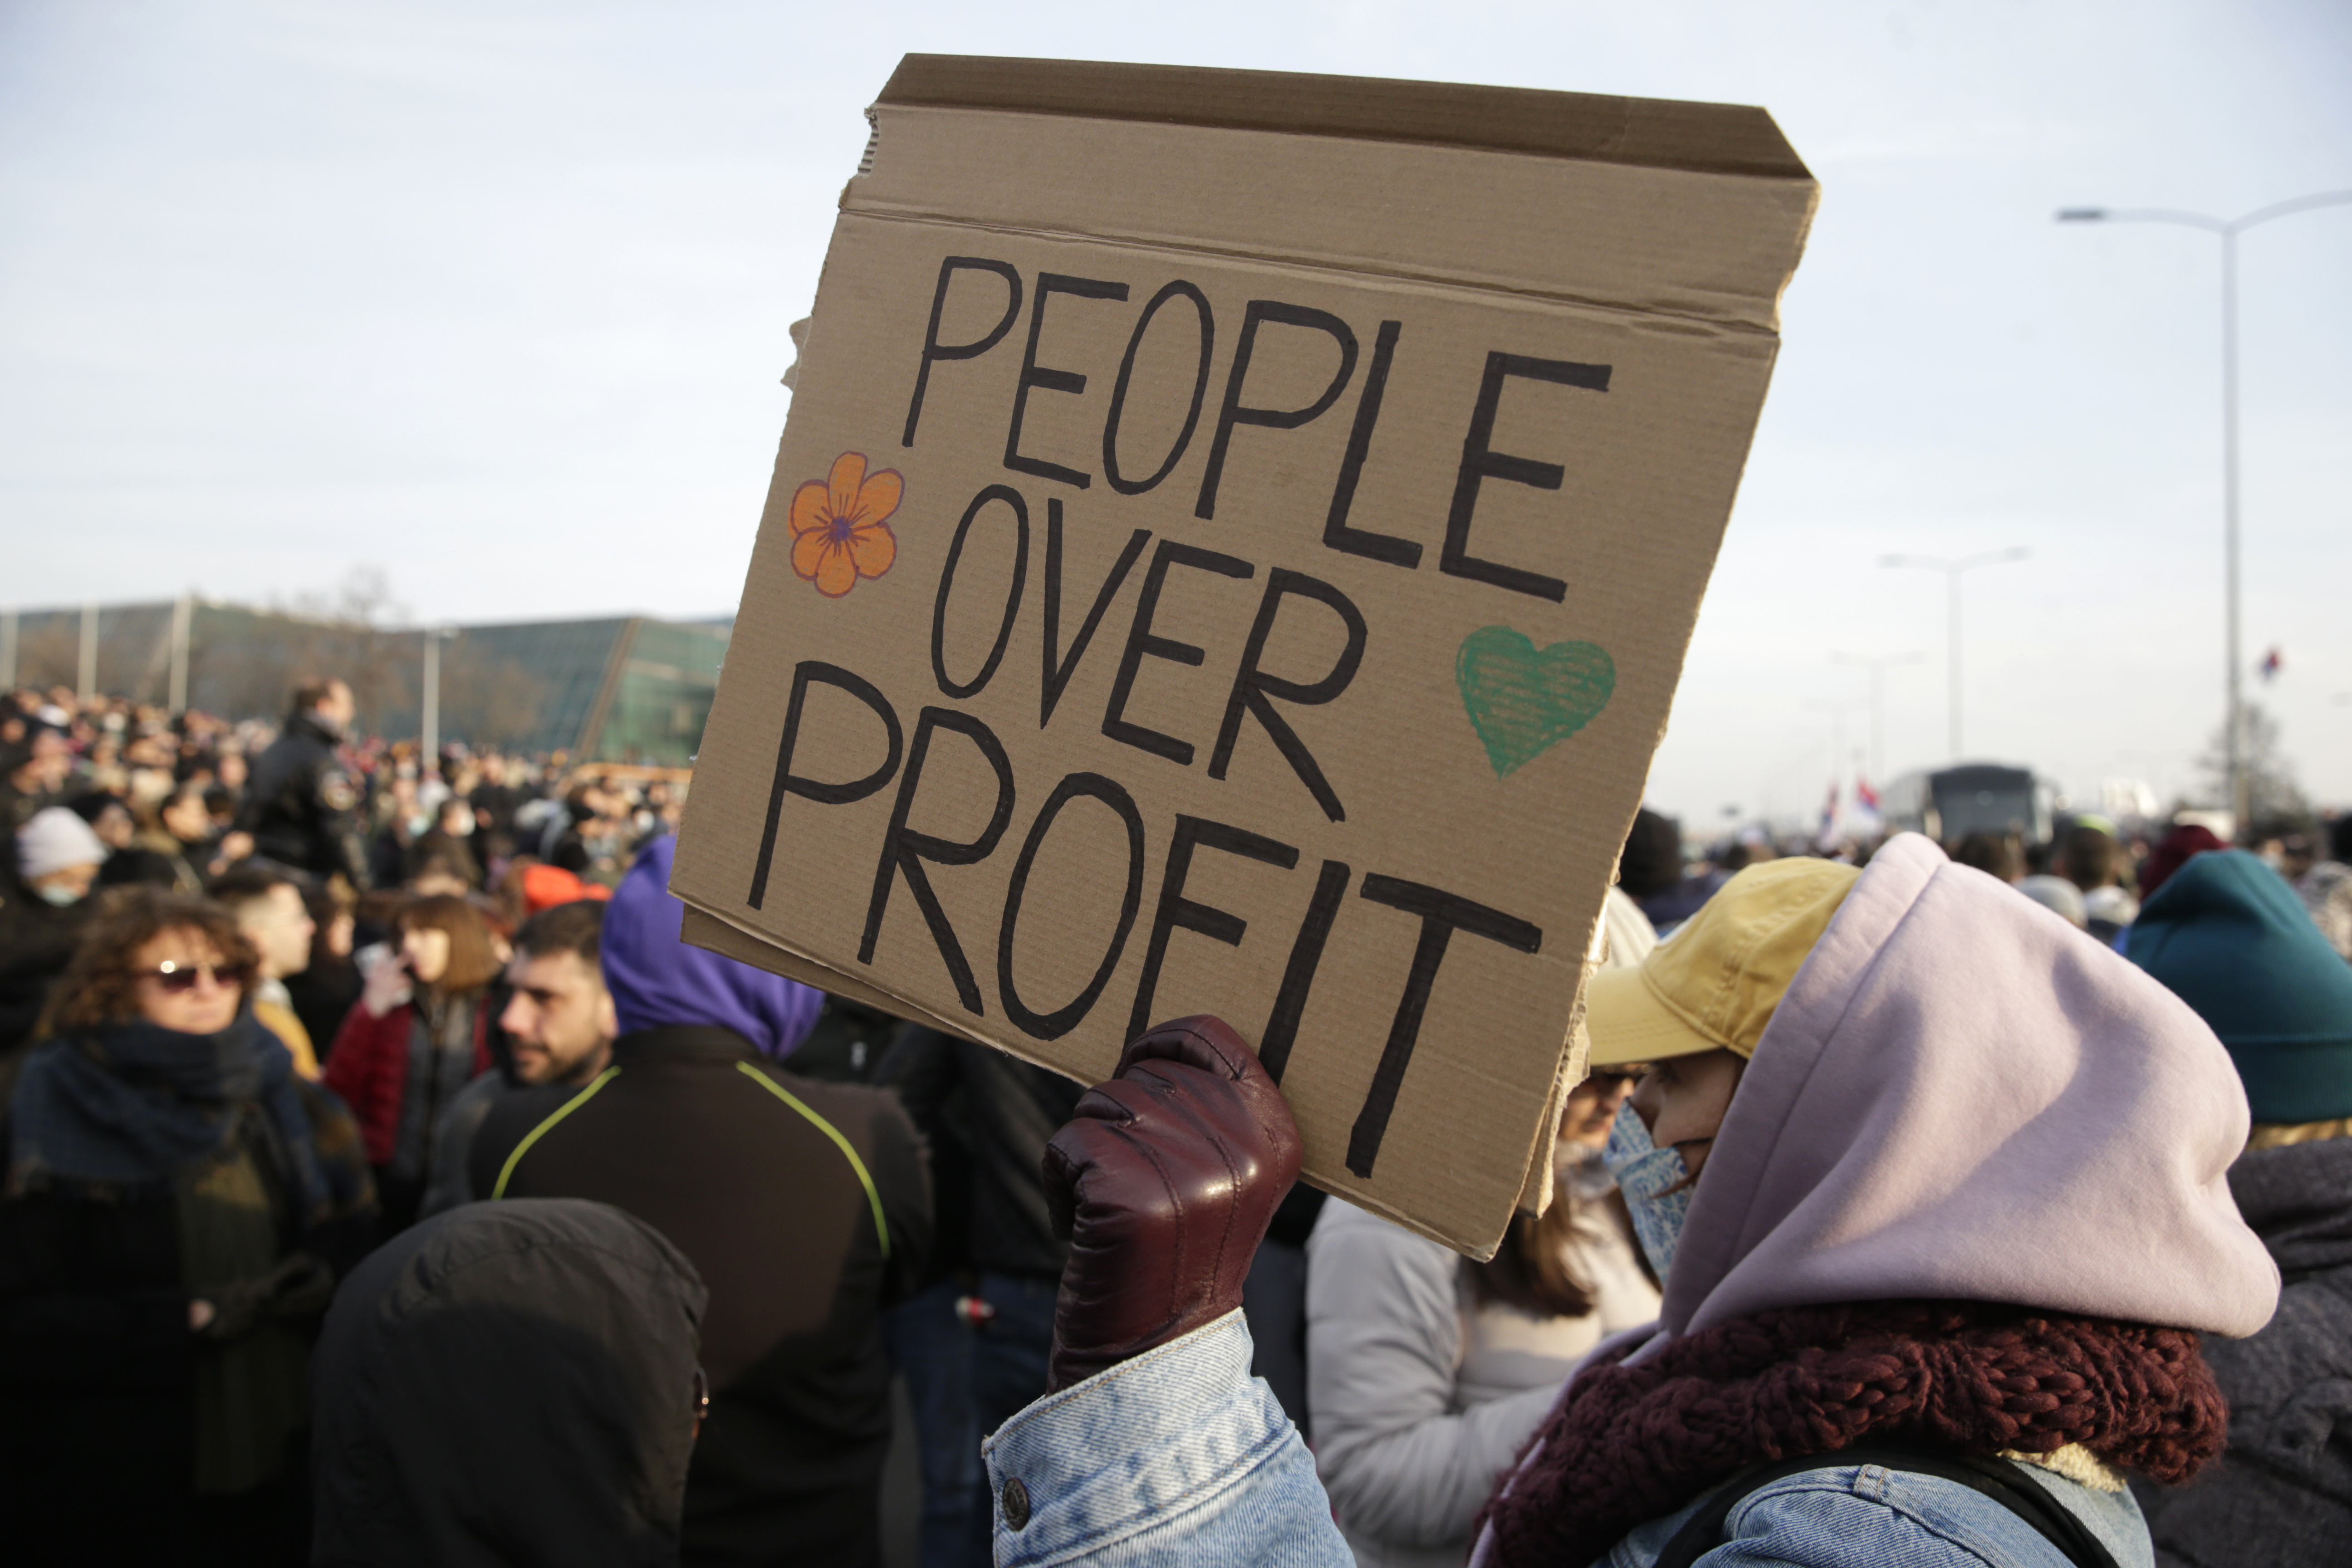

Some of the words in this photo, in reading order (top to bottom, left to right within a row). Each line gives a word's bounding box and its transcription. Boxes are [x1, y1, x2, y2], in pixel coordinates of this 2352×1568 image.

[901, 255, 1613, 603] PEOPLE
[931, 484, 1368, 822] OVER
[746, 660, 1543, 1178] PROFIT
